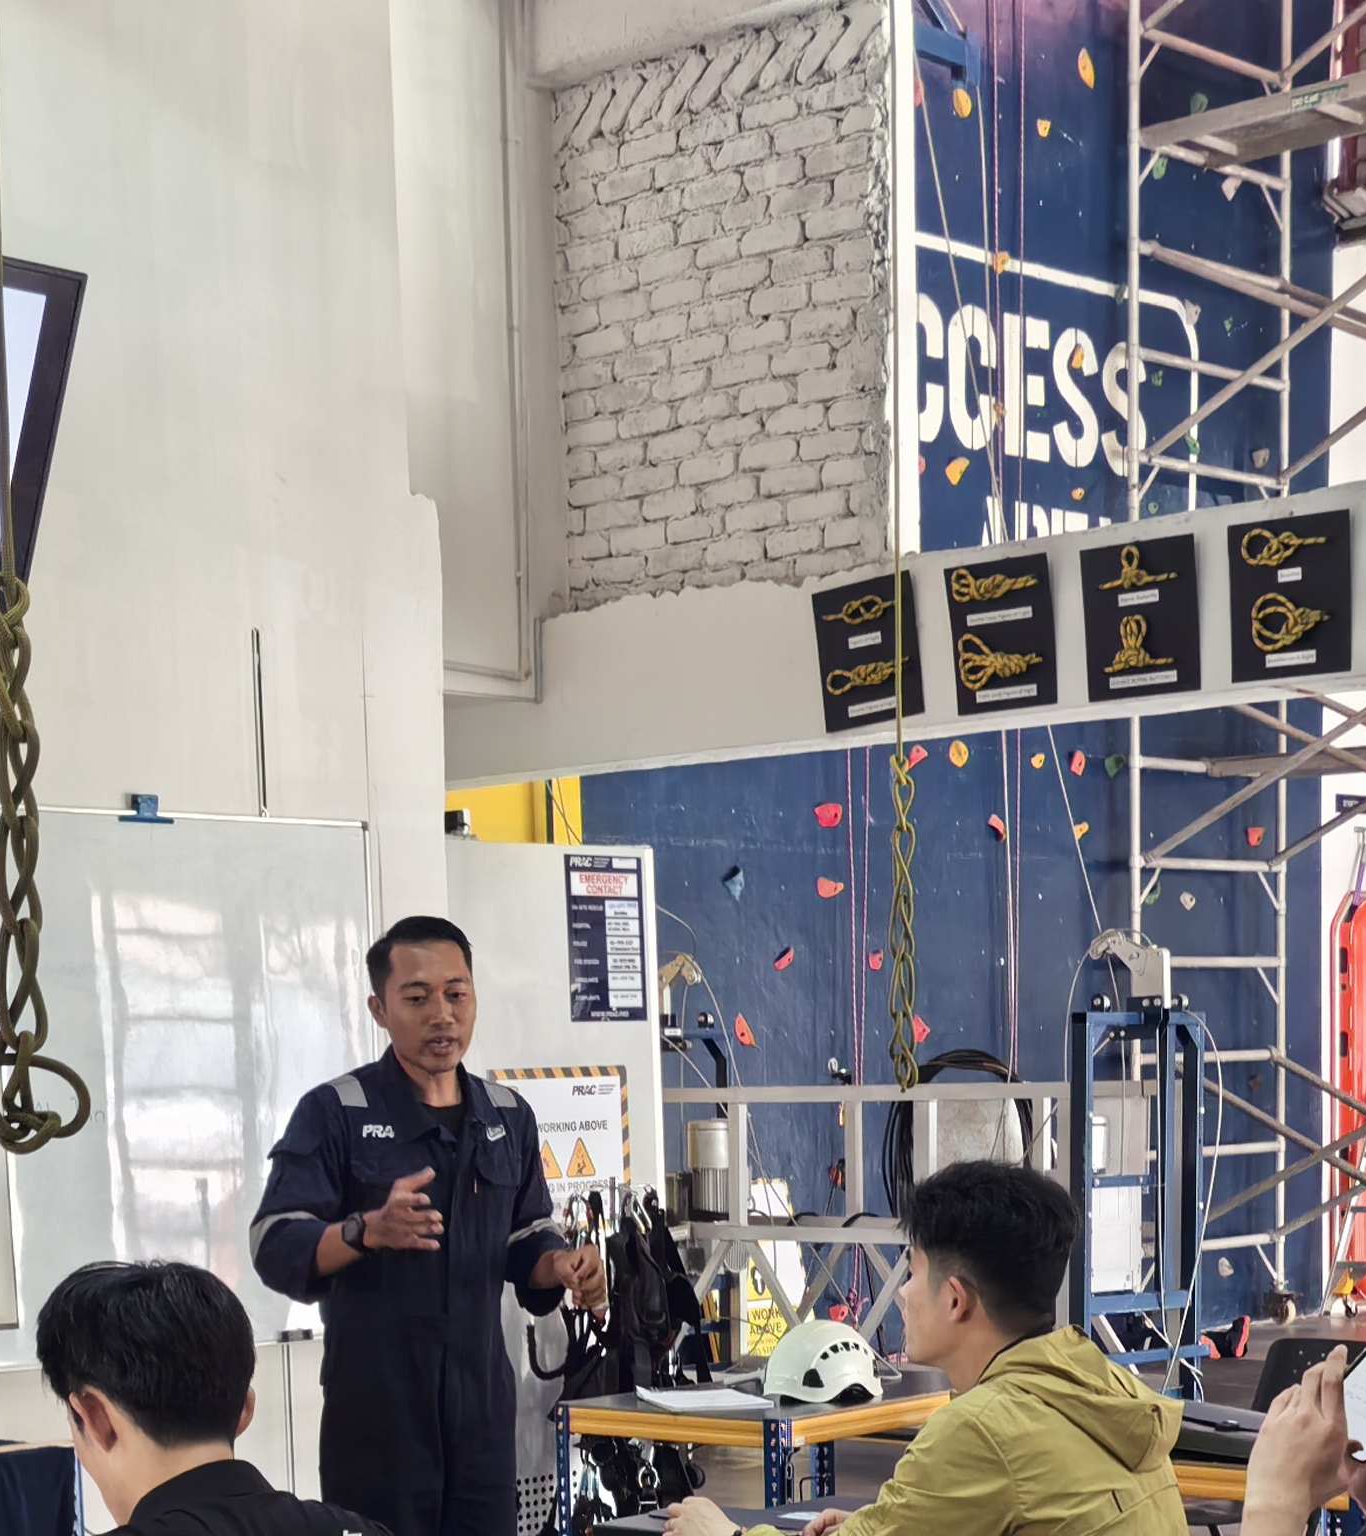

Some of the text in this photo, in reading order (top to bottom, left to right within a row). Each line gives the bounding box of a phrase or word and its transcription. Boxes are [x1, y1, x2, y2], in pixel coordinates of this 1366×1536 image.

[570, 856, 593, 867] PRAC
[579, 874, 629, 885] EMERGENCY
[586, 885, 623, 895] CONTACT
[572, 1084, 597, 1096] PRAC
[578, 1119, 608, 1132] ABOVE
